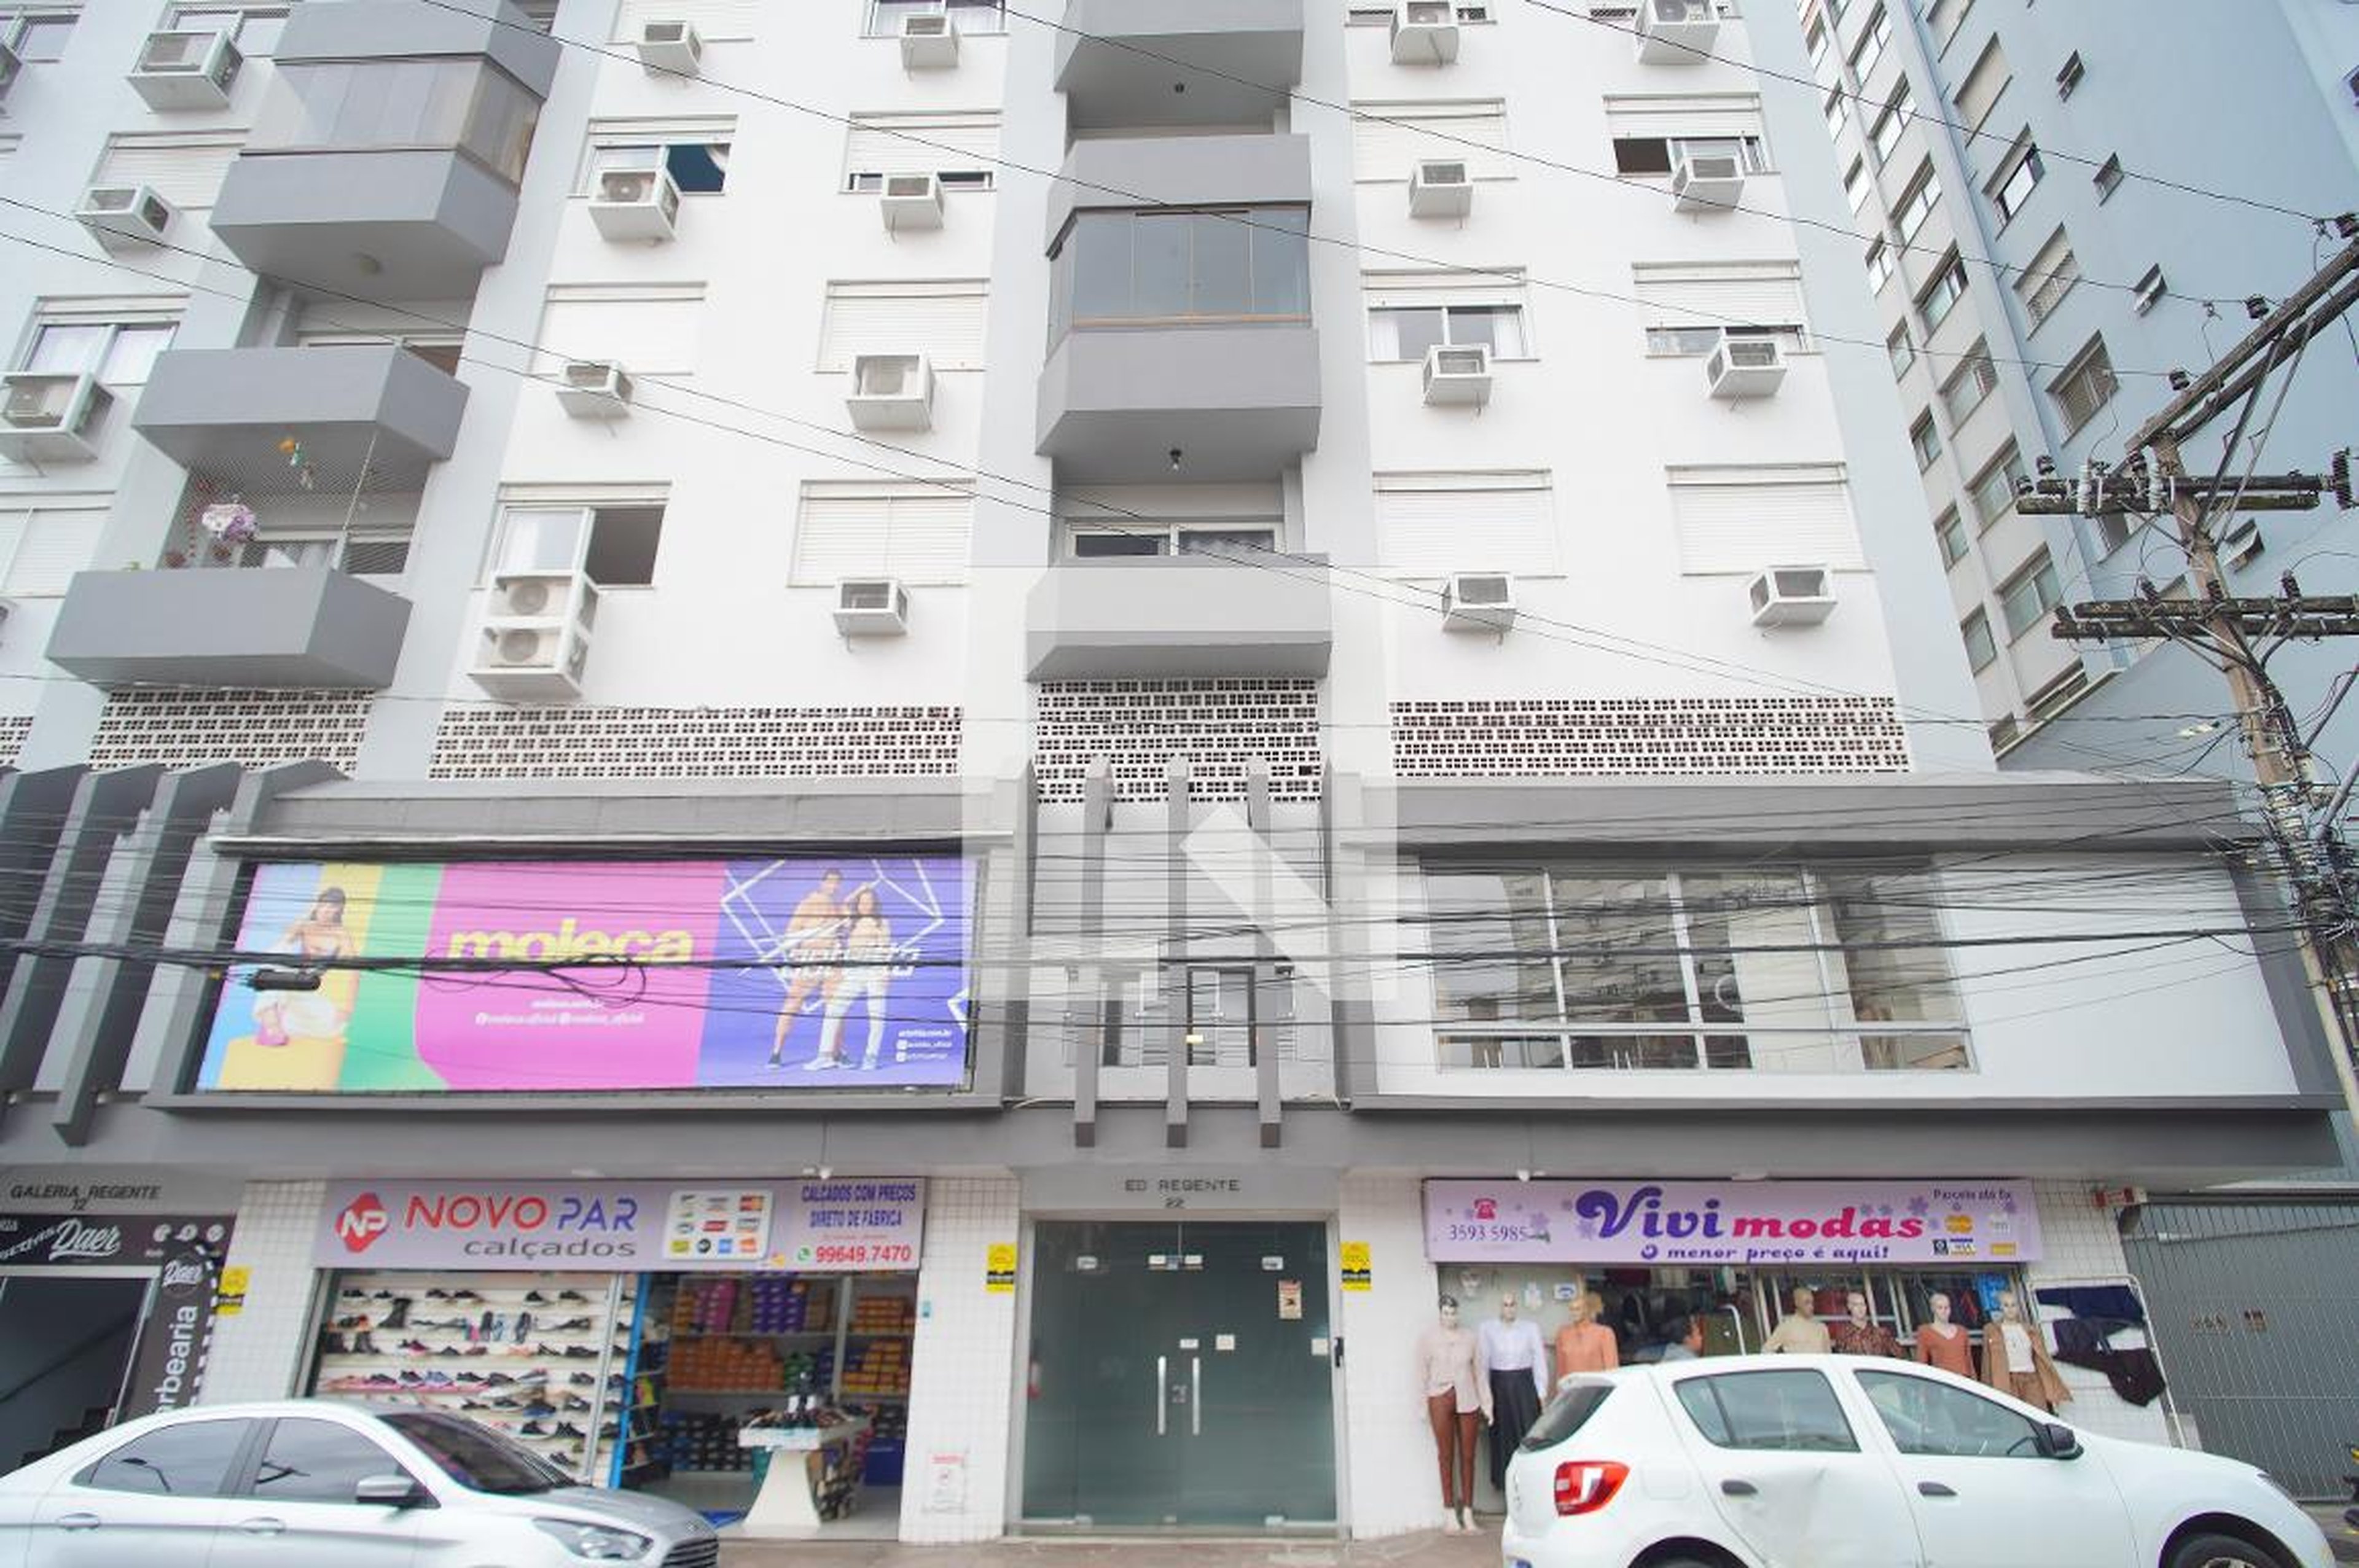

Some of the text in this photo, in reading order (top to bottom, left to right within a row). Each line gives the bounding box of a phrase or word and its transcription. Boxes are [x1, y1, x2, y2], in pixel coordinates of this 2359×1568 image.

[447, 918, 694, 963] moleca
[10, 1185, 162, 1199] GALERIA REGENTE
[1125, 1179, 1241, 1192] ED REGENTE
[70, 1198, 87, 1211] 12
[1165, 1197, 1185, 1209] 22
[405, 1195, 549, 1230] NOVO
[558, 1197, 639, 1230] PAR
[848, 1209, 860, 1227] DE
[1575, 1186, 1924, 1239] Vivi modas
[341, 1209, 387, 1238] NP
[1449, 1224, 1527, 1241] 3593 5985
[464, 1238, 636, 1260] calçados
[1667, 1246, 1737, 1258] menor
[1746, 1247, 1805, 1263] preço
[1813, 1245, 1826, 1259] é
[1833, 1246, 1889, 1263] aqui!
